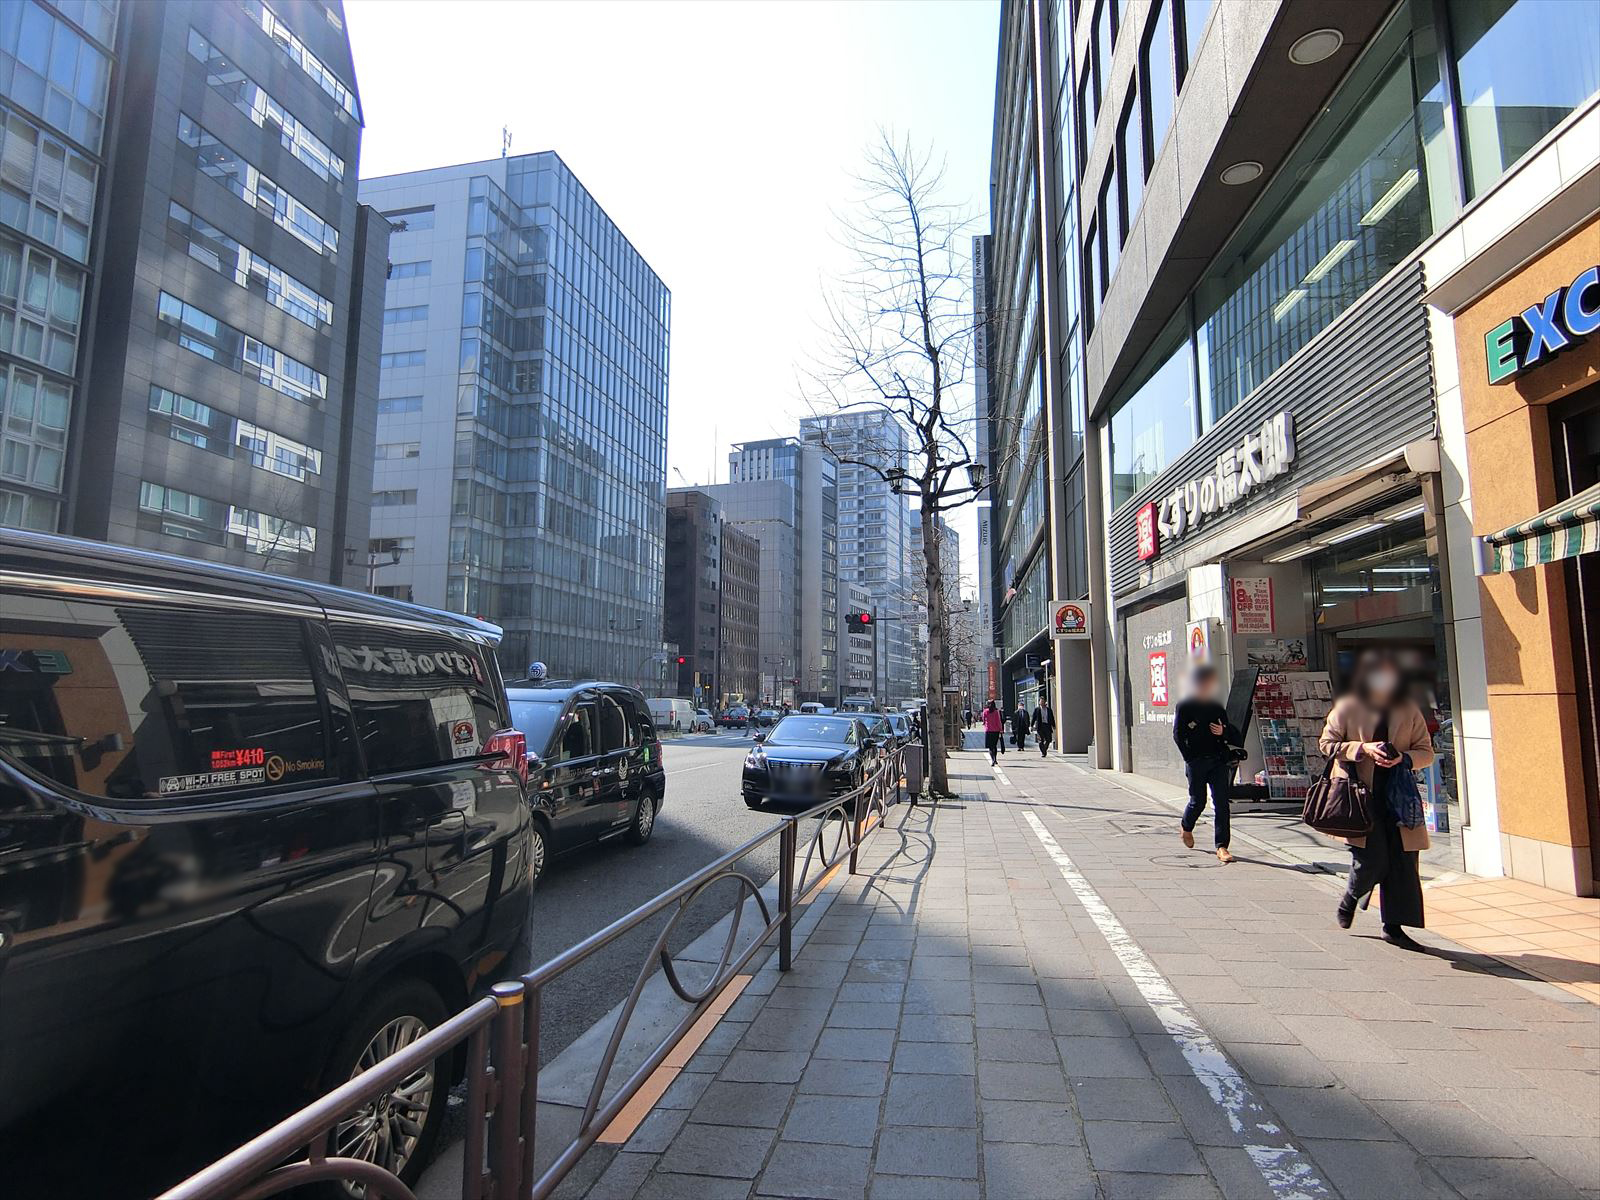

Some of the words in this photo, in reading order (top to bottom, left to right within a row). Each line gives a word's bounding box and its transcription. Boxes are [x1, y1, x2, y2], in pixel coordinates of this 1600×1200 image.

[1158, 411, 1296, 541] くすりの福太郎
[1257, 674, 1287, 683] TSUGI
[236, 747, 264, 767] ¥410
[285, 760, 296, 772] No
[296, 759, 325, 770] Smoking
[211, 772, 236, 783] FREE
[239, 768, 264, 779] SPOT
